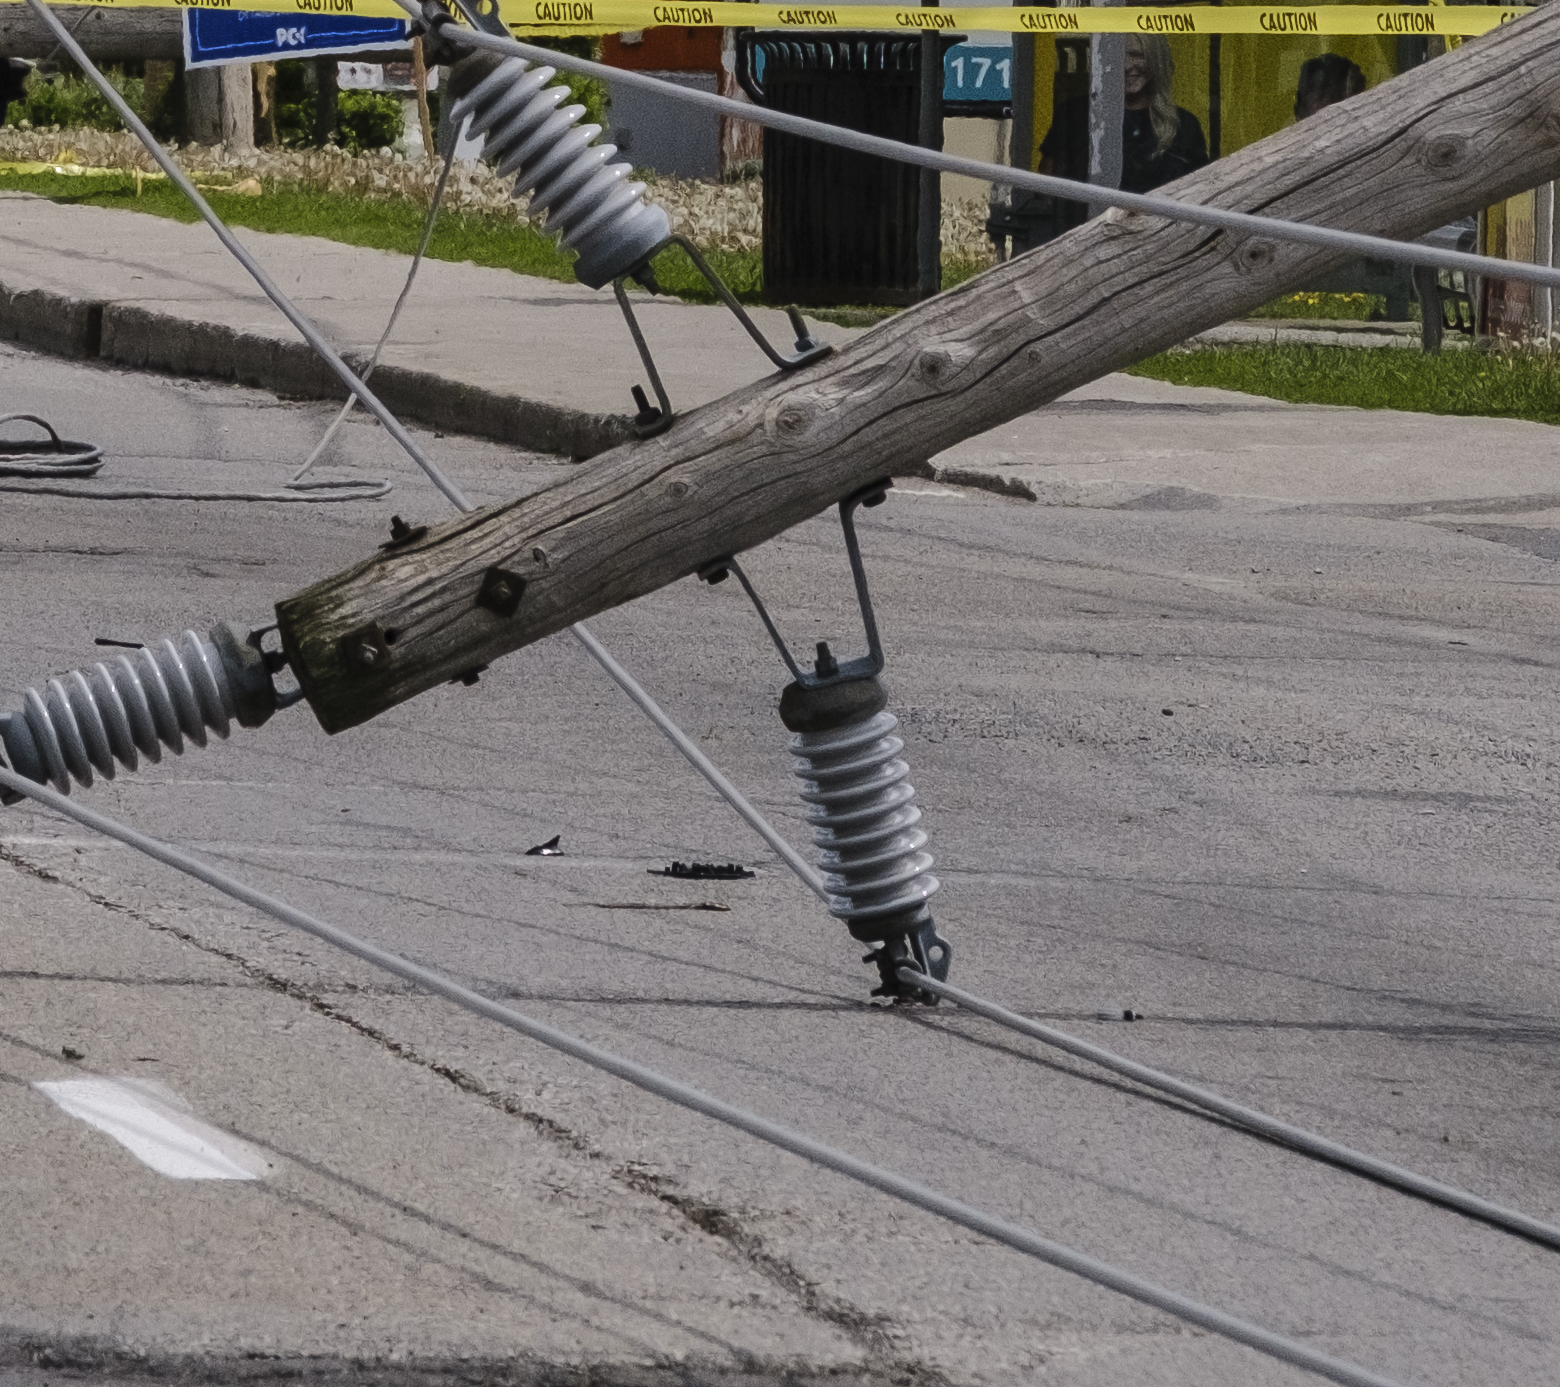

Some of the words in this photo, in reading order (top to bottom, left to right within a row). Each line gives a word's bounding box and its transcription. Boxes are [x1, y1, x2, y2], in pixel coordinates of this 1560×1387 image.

[535, 1, 594, 22] CAUTION
[653, 6, 714, 24] CAUTION
[777, 10, 837, 25] CAUTION
[895, 12, 956, 29] CAUTION
[1020, 13, 1079, 30] CAUTION
[1136, 13, 1196, 32] CAUTION
[1259, 11, 1318, 32] CAUTION
[1376, 12, 1435, 32] CAUTION
